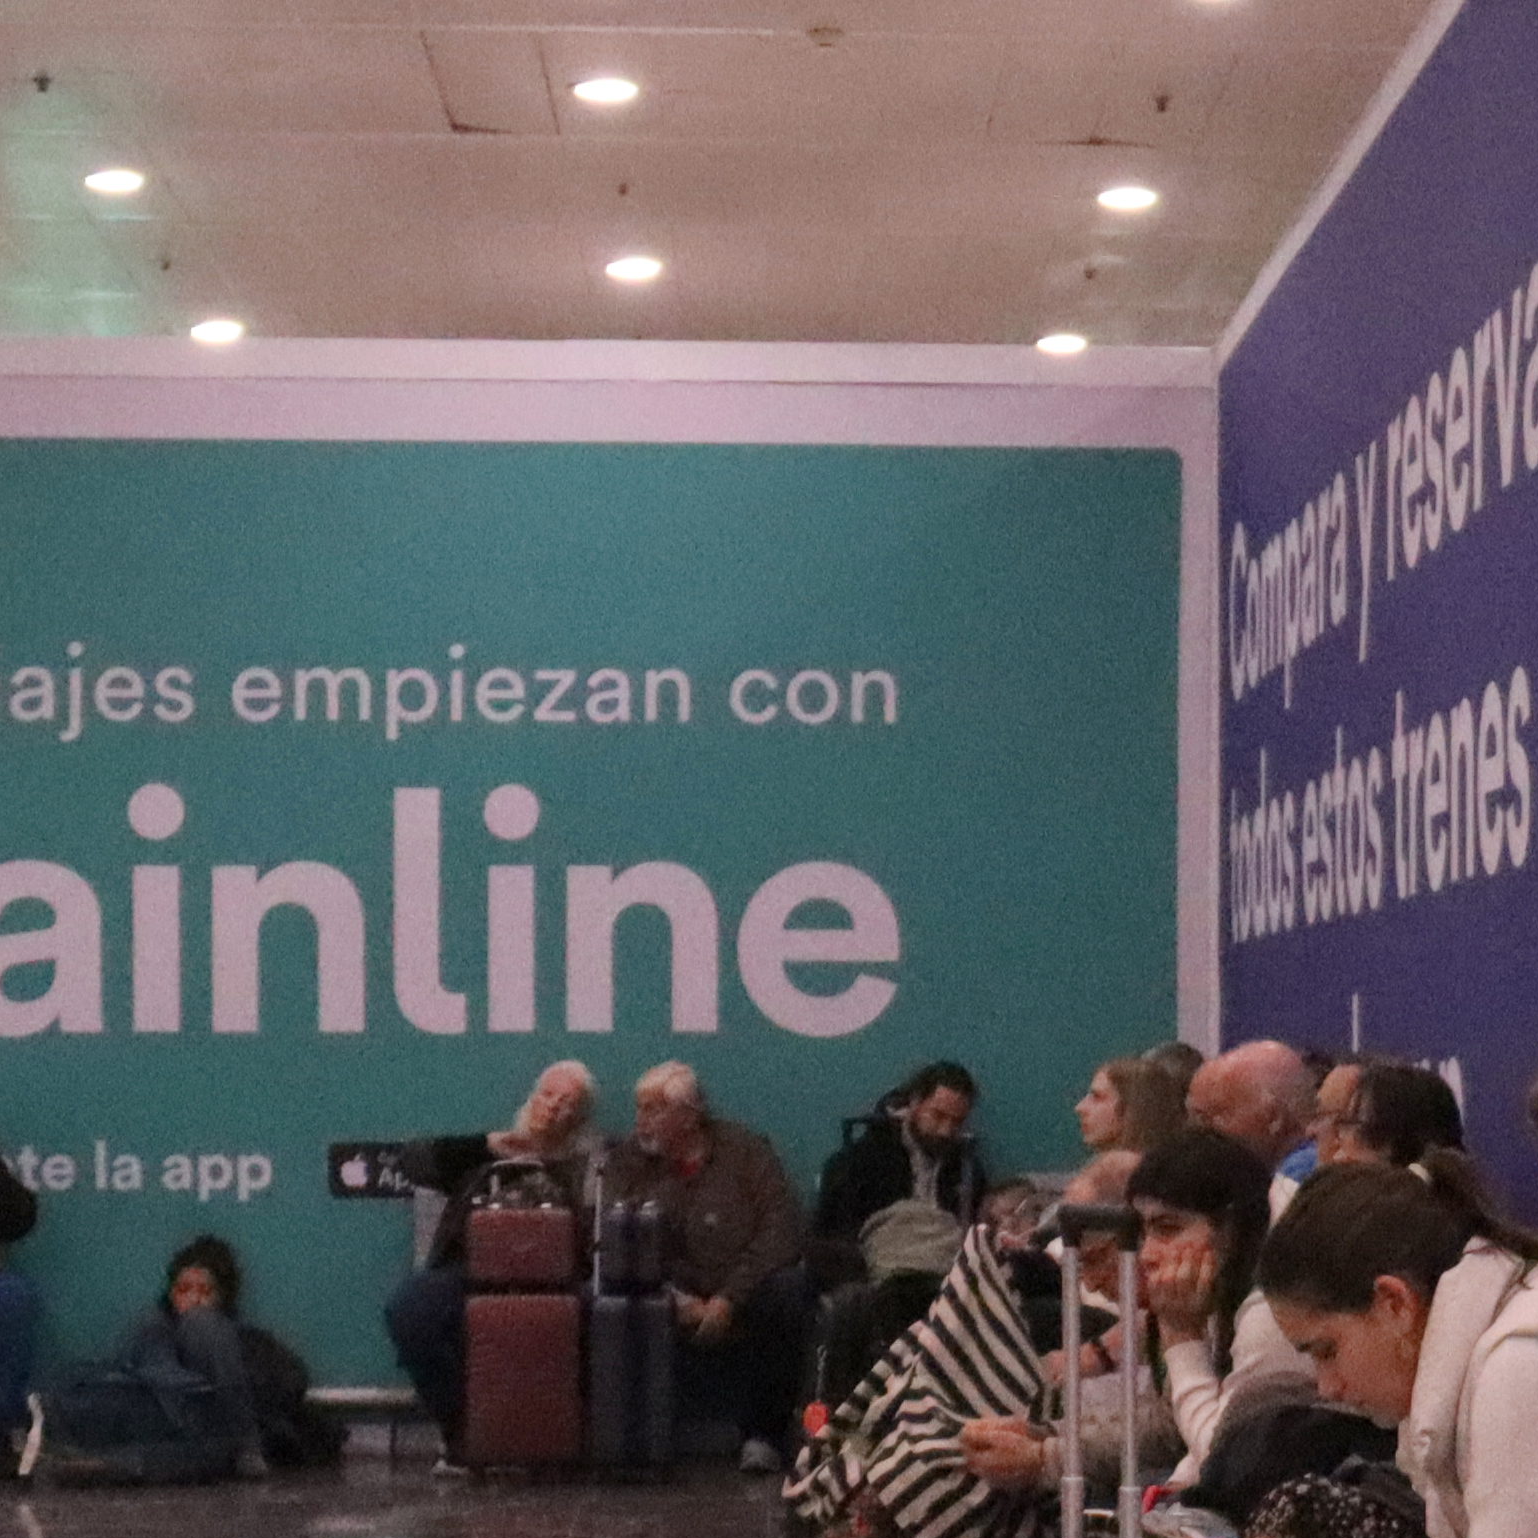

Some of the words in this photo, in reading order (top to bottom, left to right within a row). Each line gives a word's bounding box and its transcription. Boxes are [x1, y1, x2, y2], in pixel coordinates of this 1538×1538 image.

[1230, 471, 1348, 710] Compara
[1355, 441, 1377, 663] y
[231, 642, 691, 741] empiezan
[729, 667, 898, 725] con
[1229, 747, 1295, 944] todos
[1302, 724, 1383, 925] estos
[1392, 665, 1531, 900] trenes
[94, 1139, 144, 1191] la
[161, 1152, 273, 1203] app
